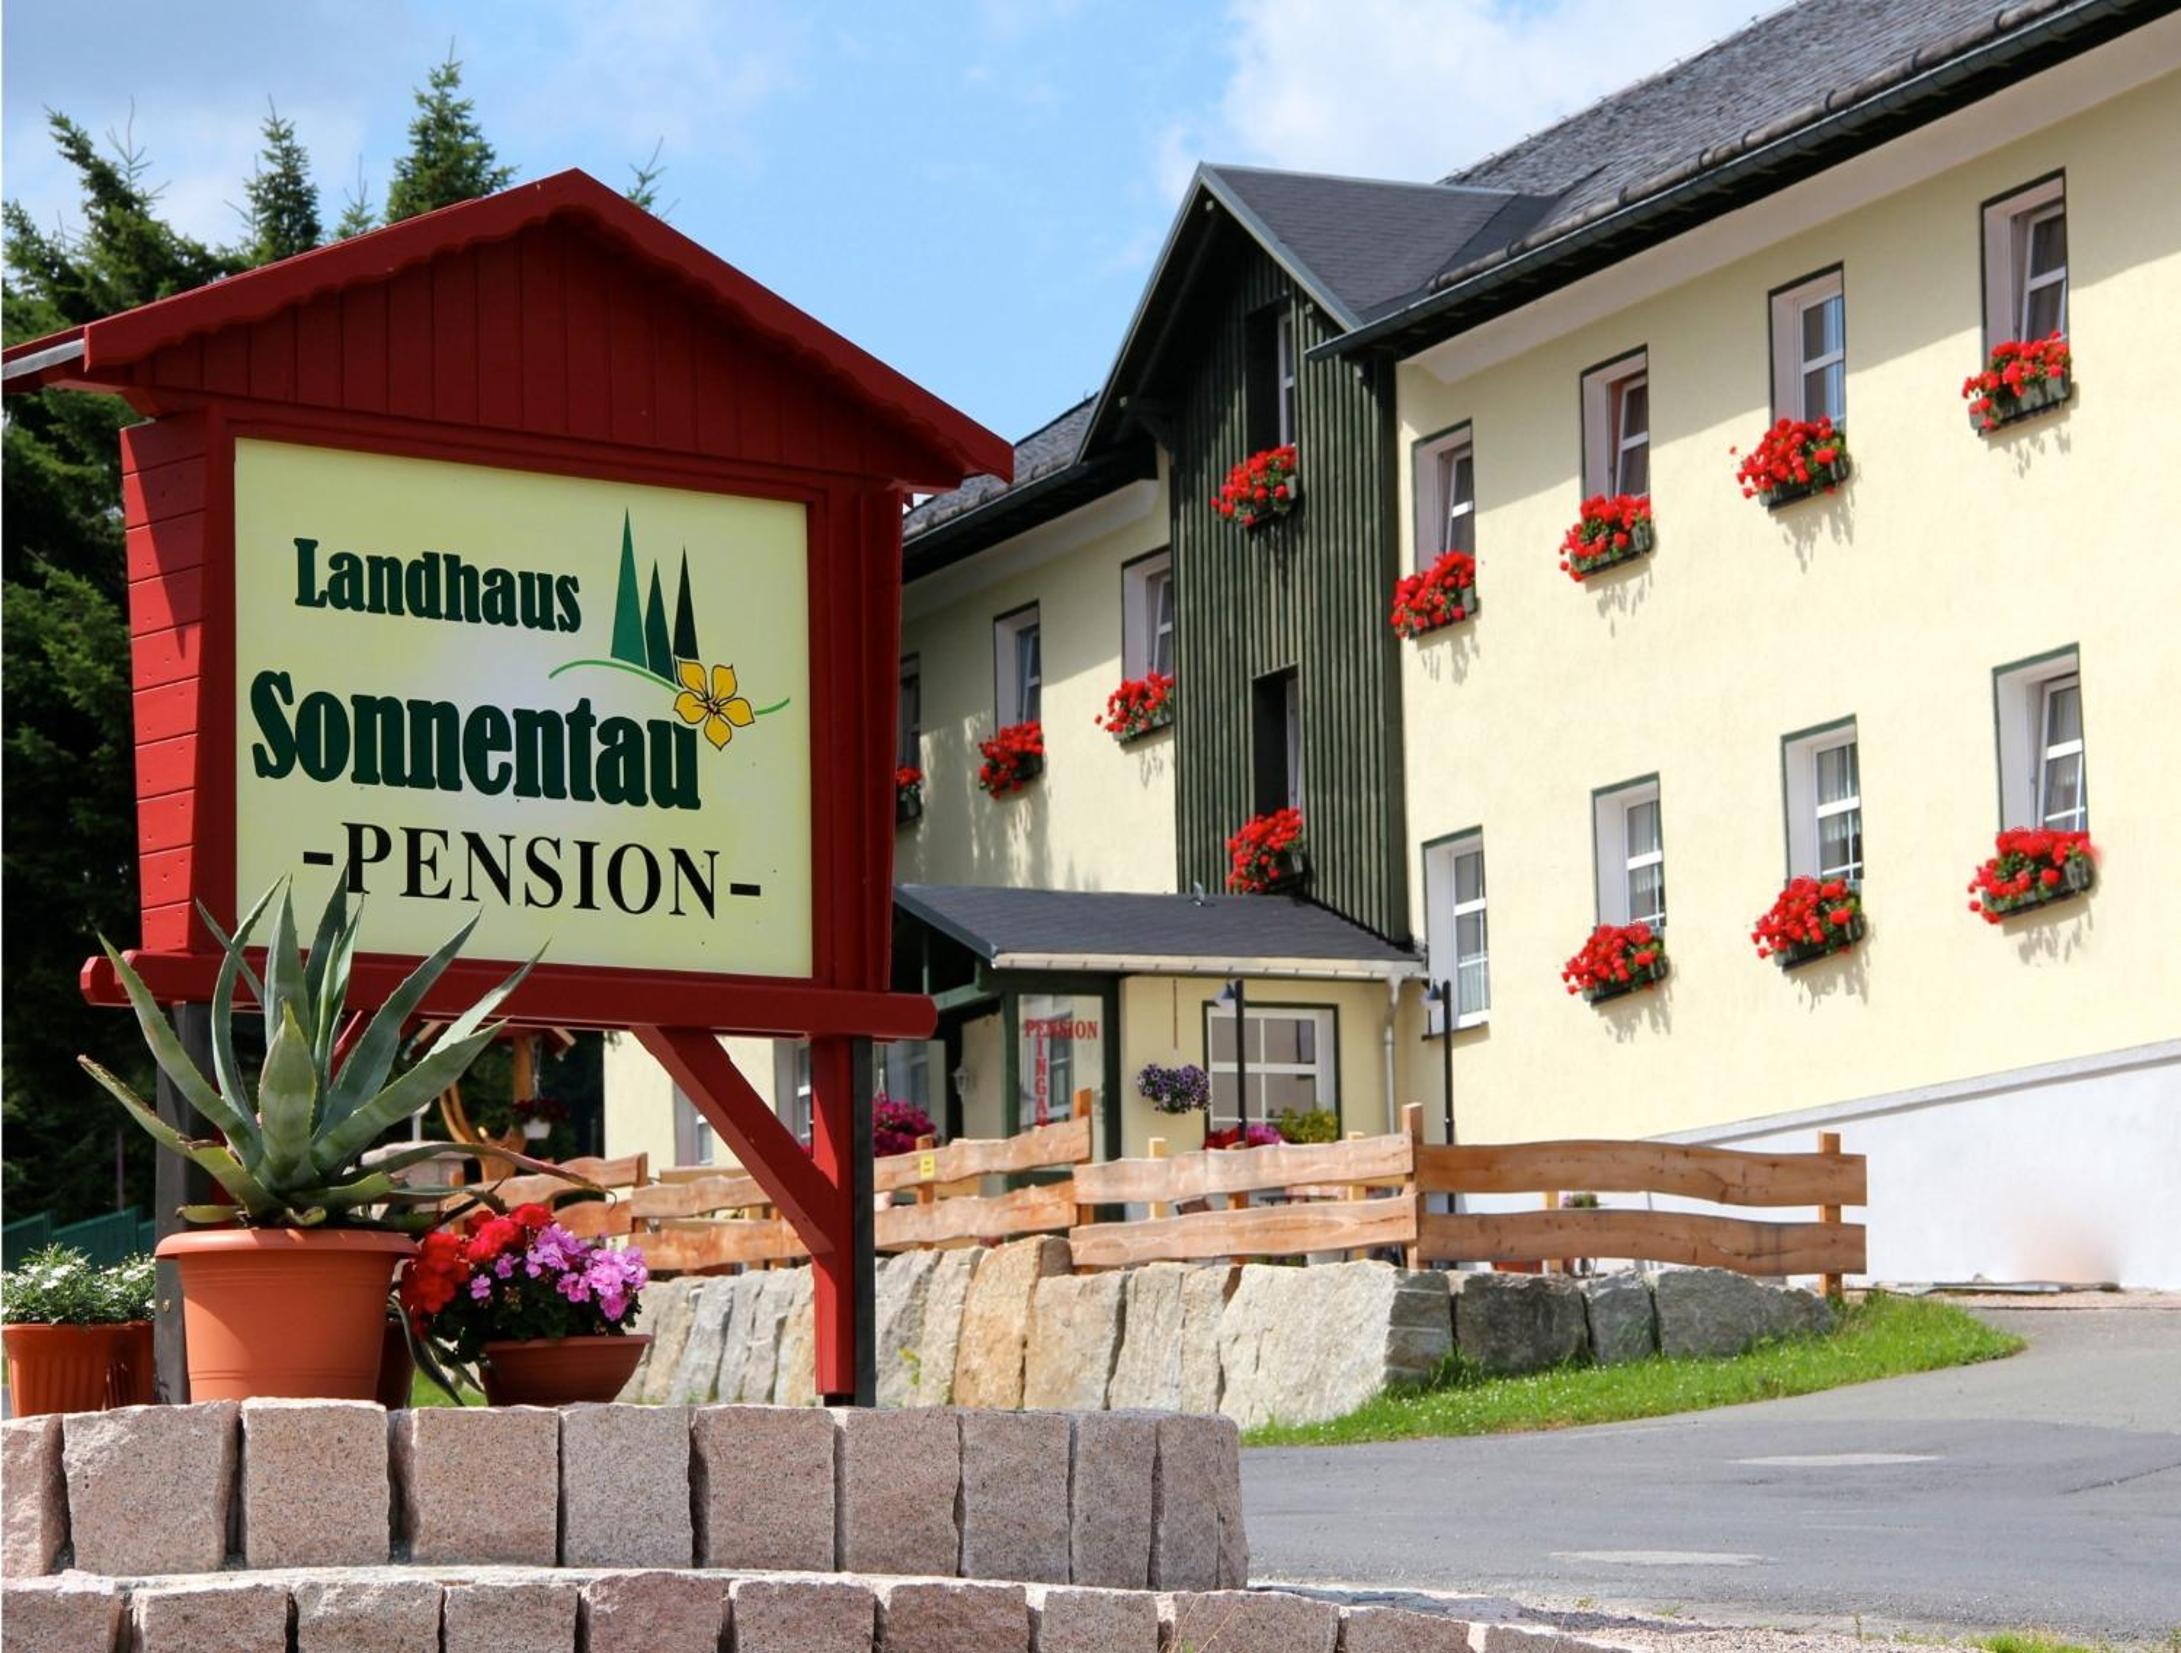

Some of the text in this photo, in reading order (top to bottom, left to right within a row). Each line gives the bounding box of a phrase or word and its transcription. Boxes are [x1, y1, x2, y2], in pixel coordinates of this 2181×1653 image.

[294, 538, 582, 633] Landhaus
[250, 670, 701, 811] Sonnentau
[1024, 1019, 1098, 1039] PENSION
